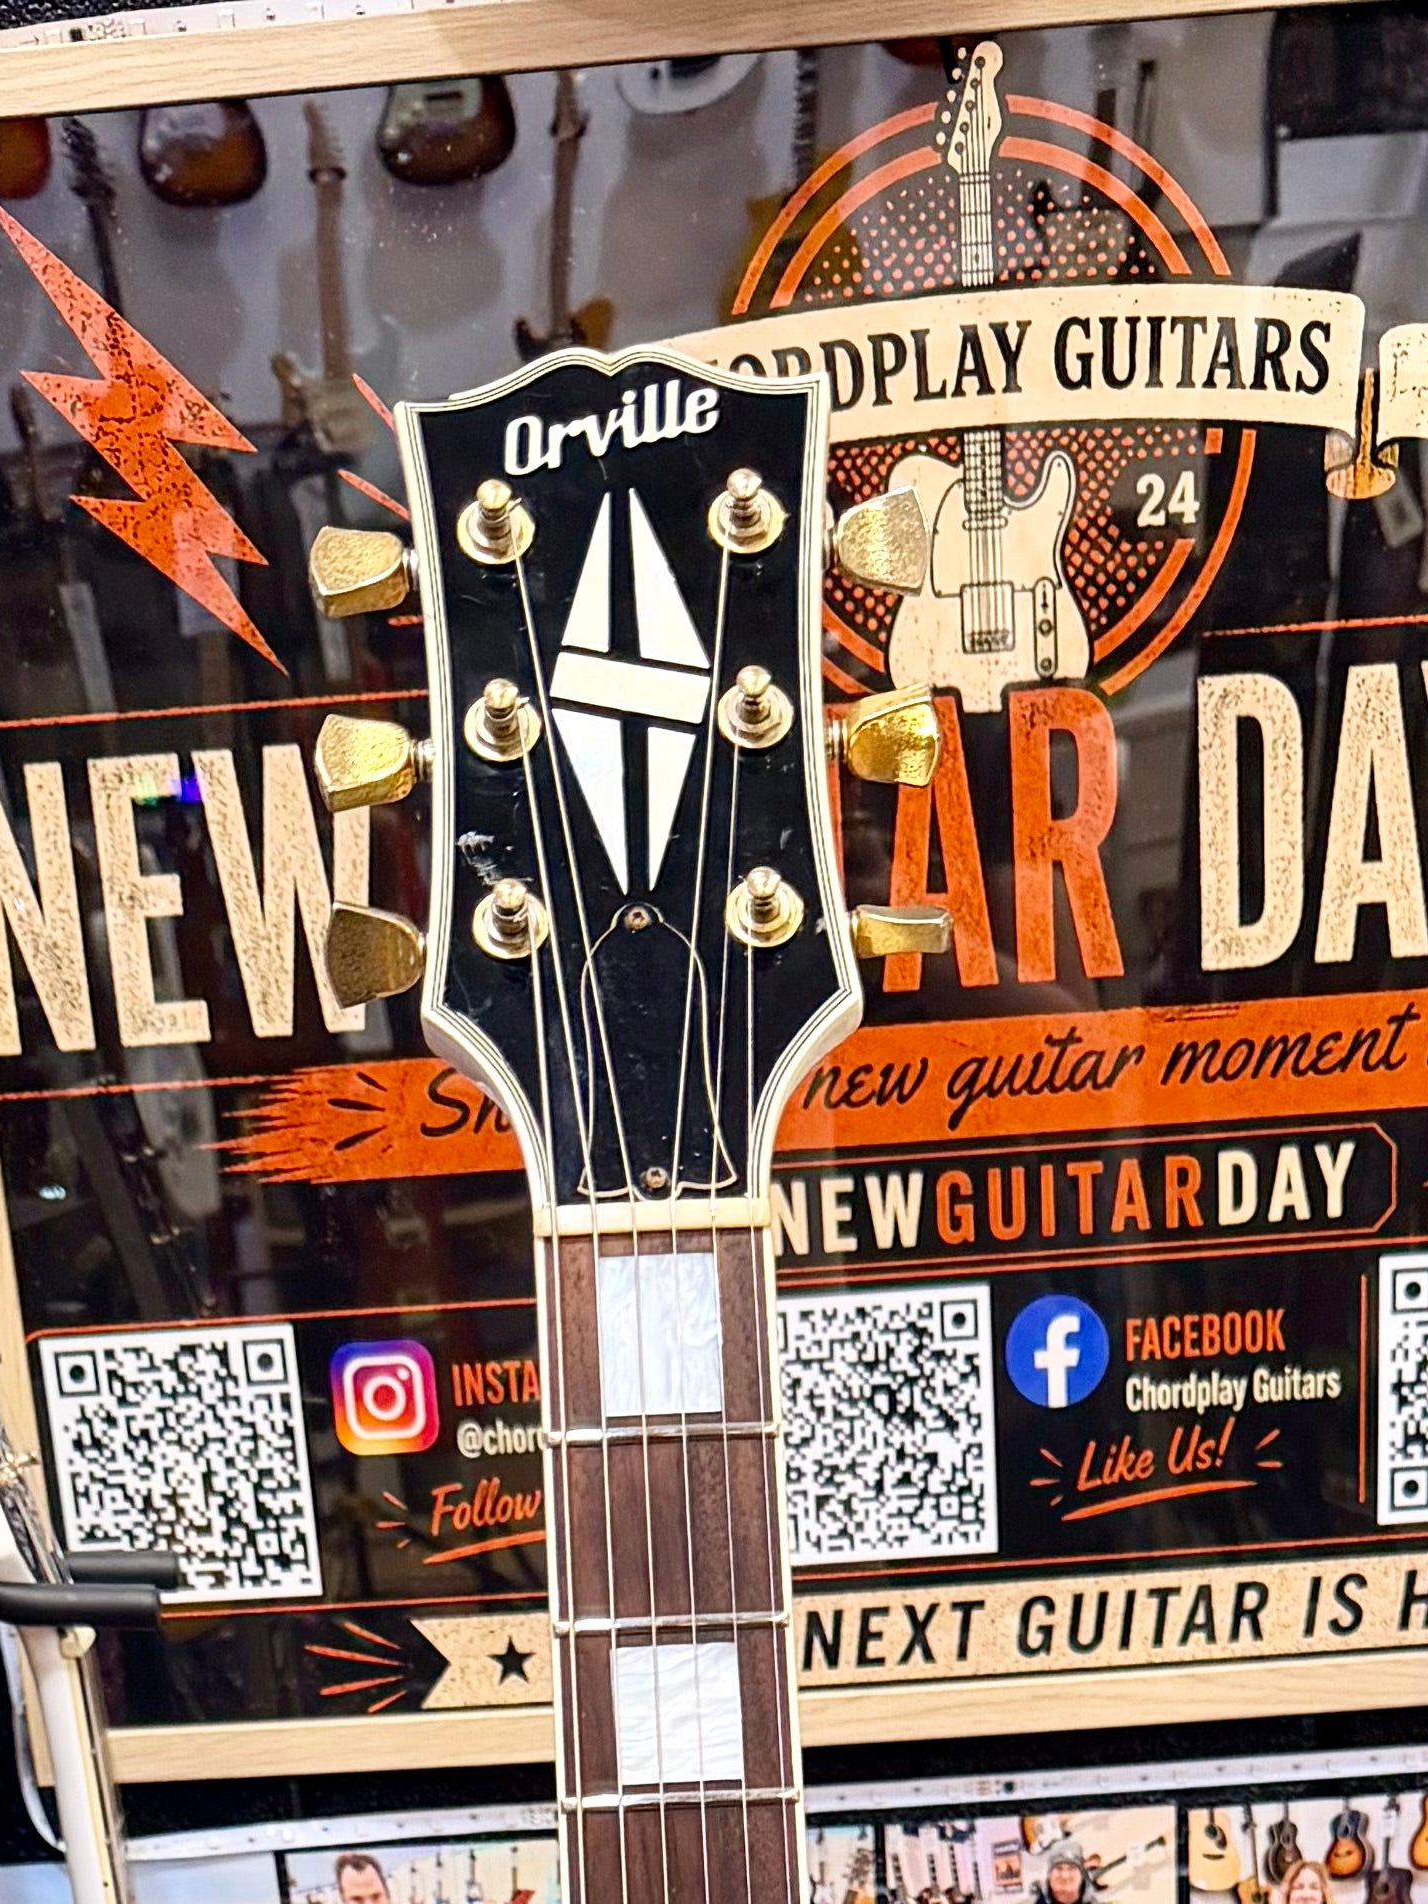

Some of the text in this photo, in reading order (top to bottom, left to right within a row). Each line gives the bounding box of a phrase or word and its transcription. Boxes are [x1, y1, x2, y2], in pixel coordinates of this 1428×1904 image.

[1054, 314, 1332, 397] GUITARS
[503, 377, 721, 478] Orville
[1134, 470, 1202, 529] 24
[803, 1063, 929, 1112] new
[945, 1027, 1148, 1132] guitar
[1160, 1003, 1428, 1088] moment
[1125, 1308, 1286, 1361] FACEBOOK
[1125, 1368, 1342, 1416] Chordplay Guitars
[1077, 1417, 1231, 1492] Like Us!
[429, 1475, 542, 1537] Follow
[802, 1599, 985, 1673] NEXT
[1016, 1580, 1271, 1658] GUITAR
[1302, 1572, 1369, 1640] IS
